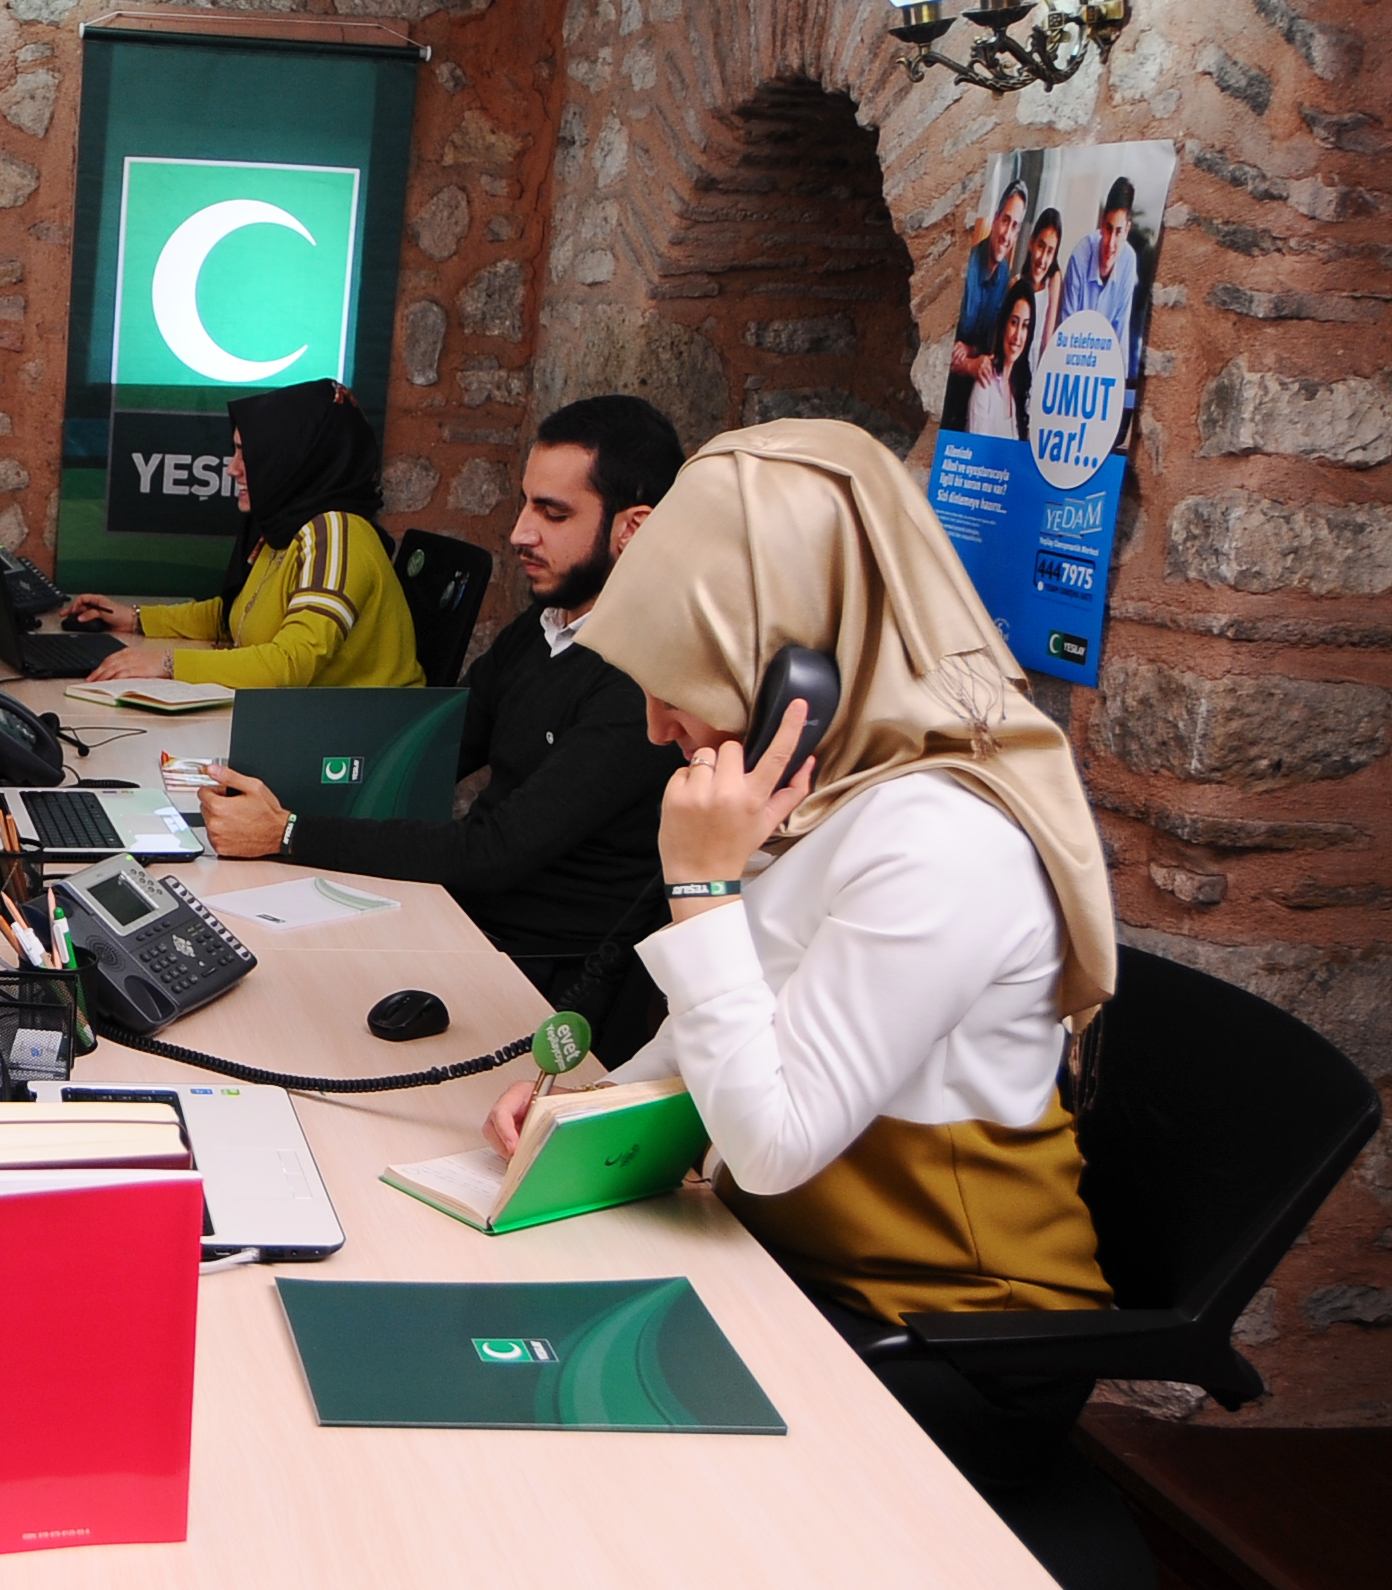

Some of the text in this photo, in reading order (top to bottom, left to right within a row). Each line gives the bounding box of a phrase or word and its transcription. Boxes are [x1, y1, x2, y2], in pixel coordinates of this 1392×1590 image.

[1056, 332, 1113, 351] Bu telefonun
[1065, 352, 1098, 368] ucunda
[1042, 371, 1117, 421] UMUT
[1046, 500, 1103, 532] YEDAM
[557, 1024, 581, 1063] evet
